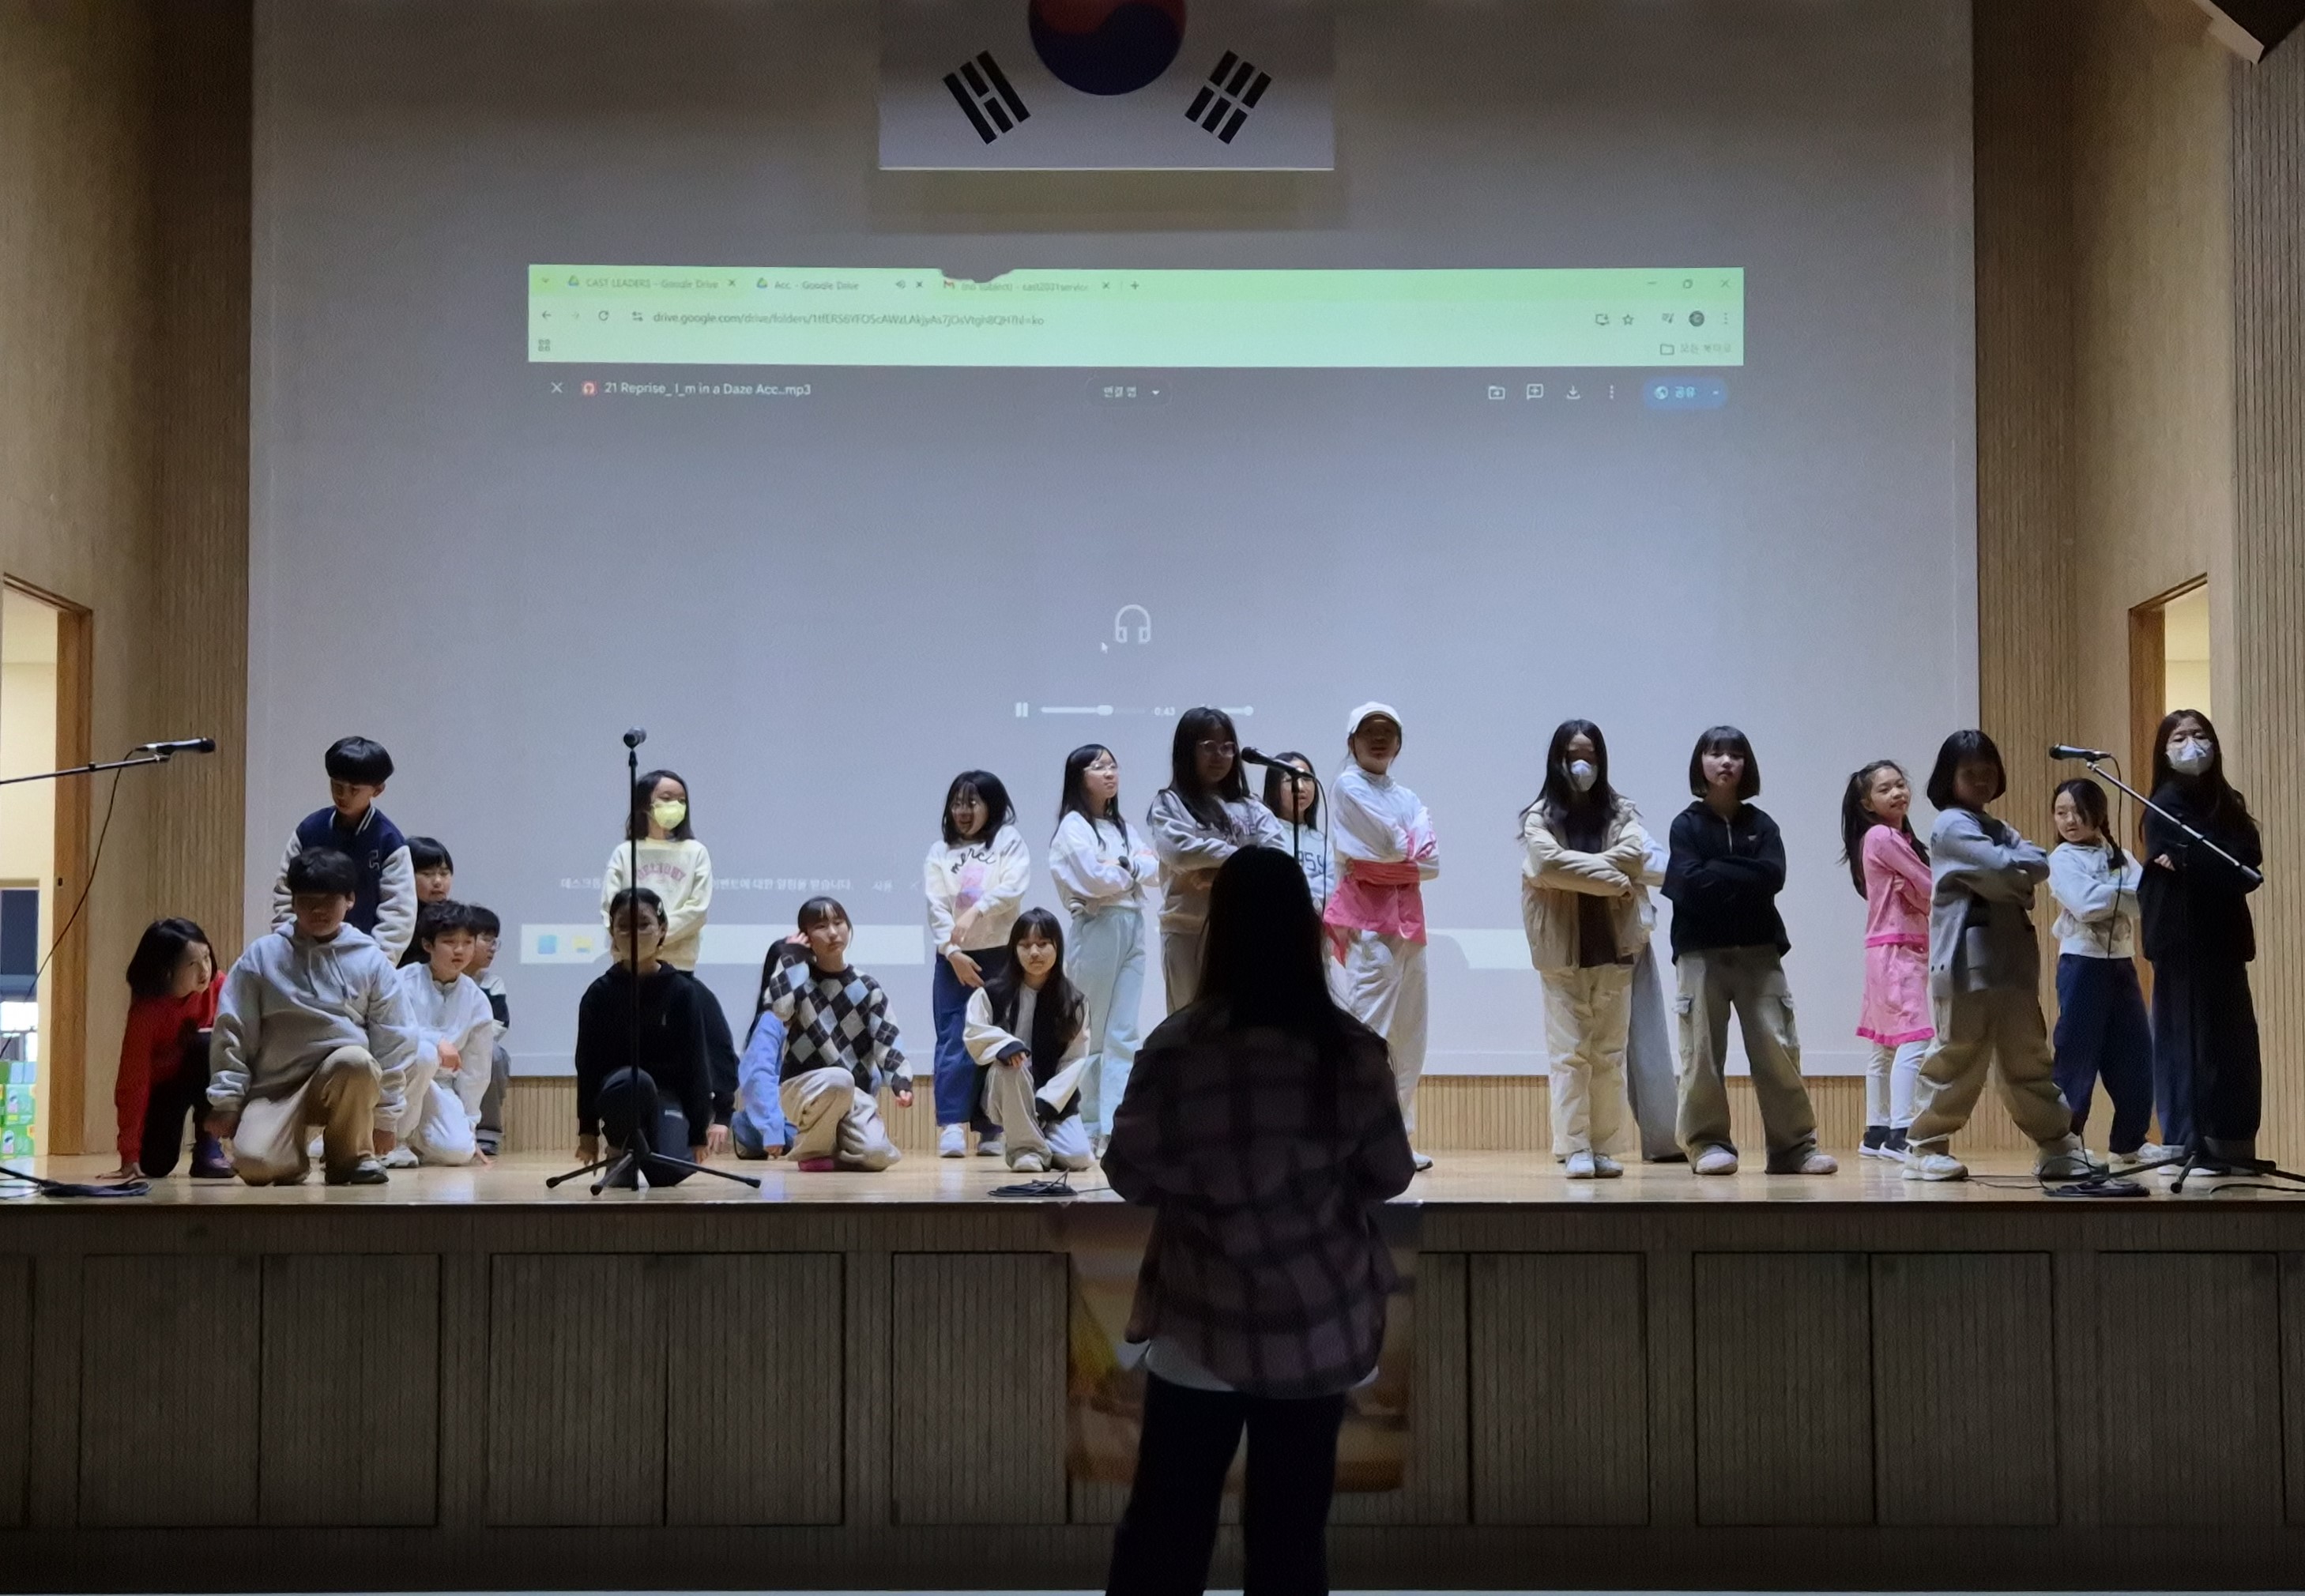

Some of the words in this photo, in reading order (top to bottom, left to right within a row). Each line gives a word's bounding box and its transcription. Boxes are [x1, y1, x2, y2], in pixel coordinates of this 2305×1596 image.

[604, 382, 617, 394] 21
[699, 382, 710, 395] in
[713, 386, 721, 395] a
[723, 383, 751, 395] Daze
[951, 848, 996, 874] merci
